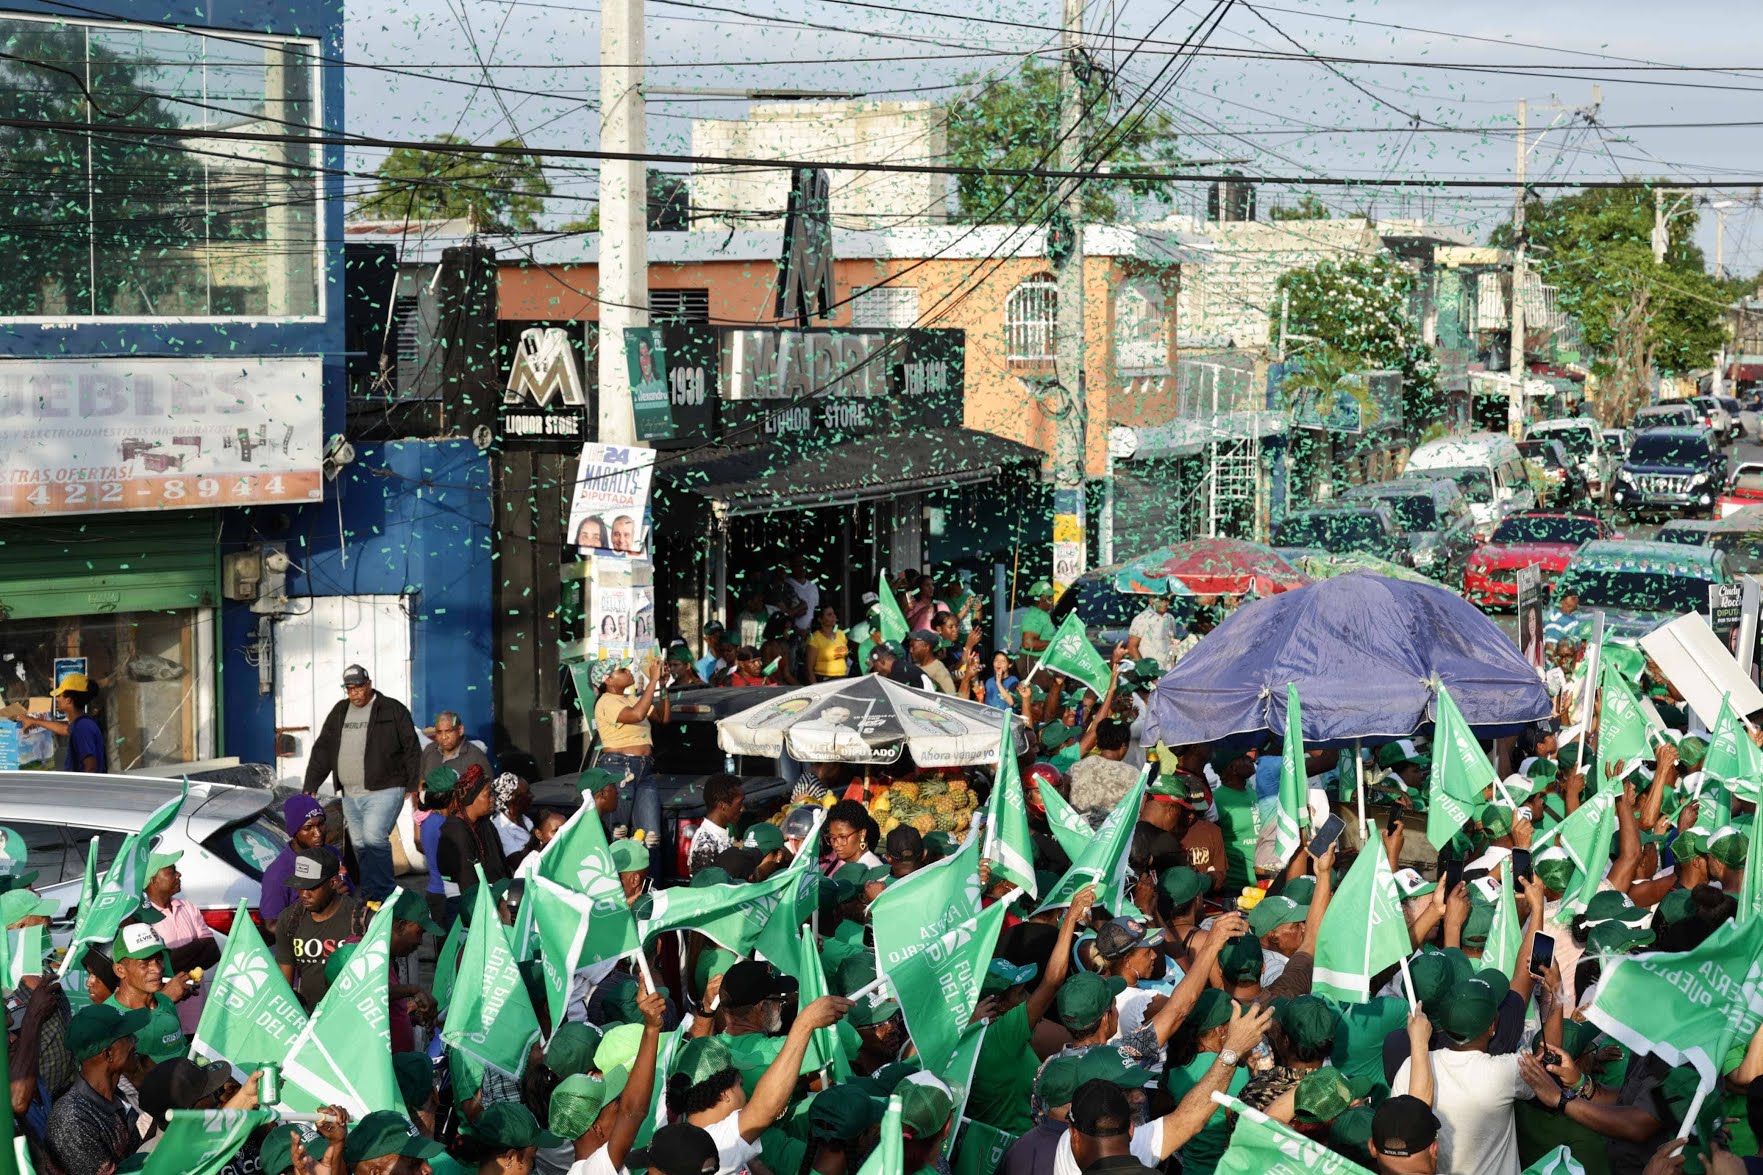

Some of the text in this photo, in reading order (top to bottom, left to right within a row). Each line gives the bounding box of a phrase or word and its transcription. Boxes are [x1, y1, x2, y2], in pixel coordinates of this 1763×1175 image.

[669, 367, 704, 405] 1930
[505, 415, 579, 436] LIQUOR STORE
[765, 404, 866, 434] LIQUOR STORE
[603, 447, 630, 464] 24
[55, 466, 134, 481] OFERTAS!
[583, 464, 640, 495] MAGALYS
[581, 490, 634, 505] DIPUTADA
[1719, 585, 1741, 600] Cindy
[841, 748, 896, 757] DIPUTADO
[921, 748, 995, 762] Ahora vengo yo
[213, 984, 245, 1009] FP
[939, 972, 960, 1004] DEL
[954, 960, 979, 1014] FUERZ
[256, 1010, 288, 1040] DEL
[267, 995, 308, 1033] FUER
[356, 997, 383, 1029] DEL
